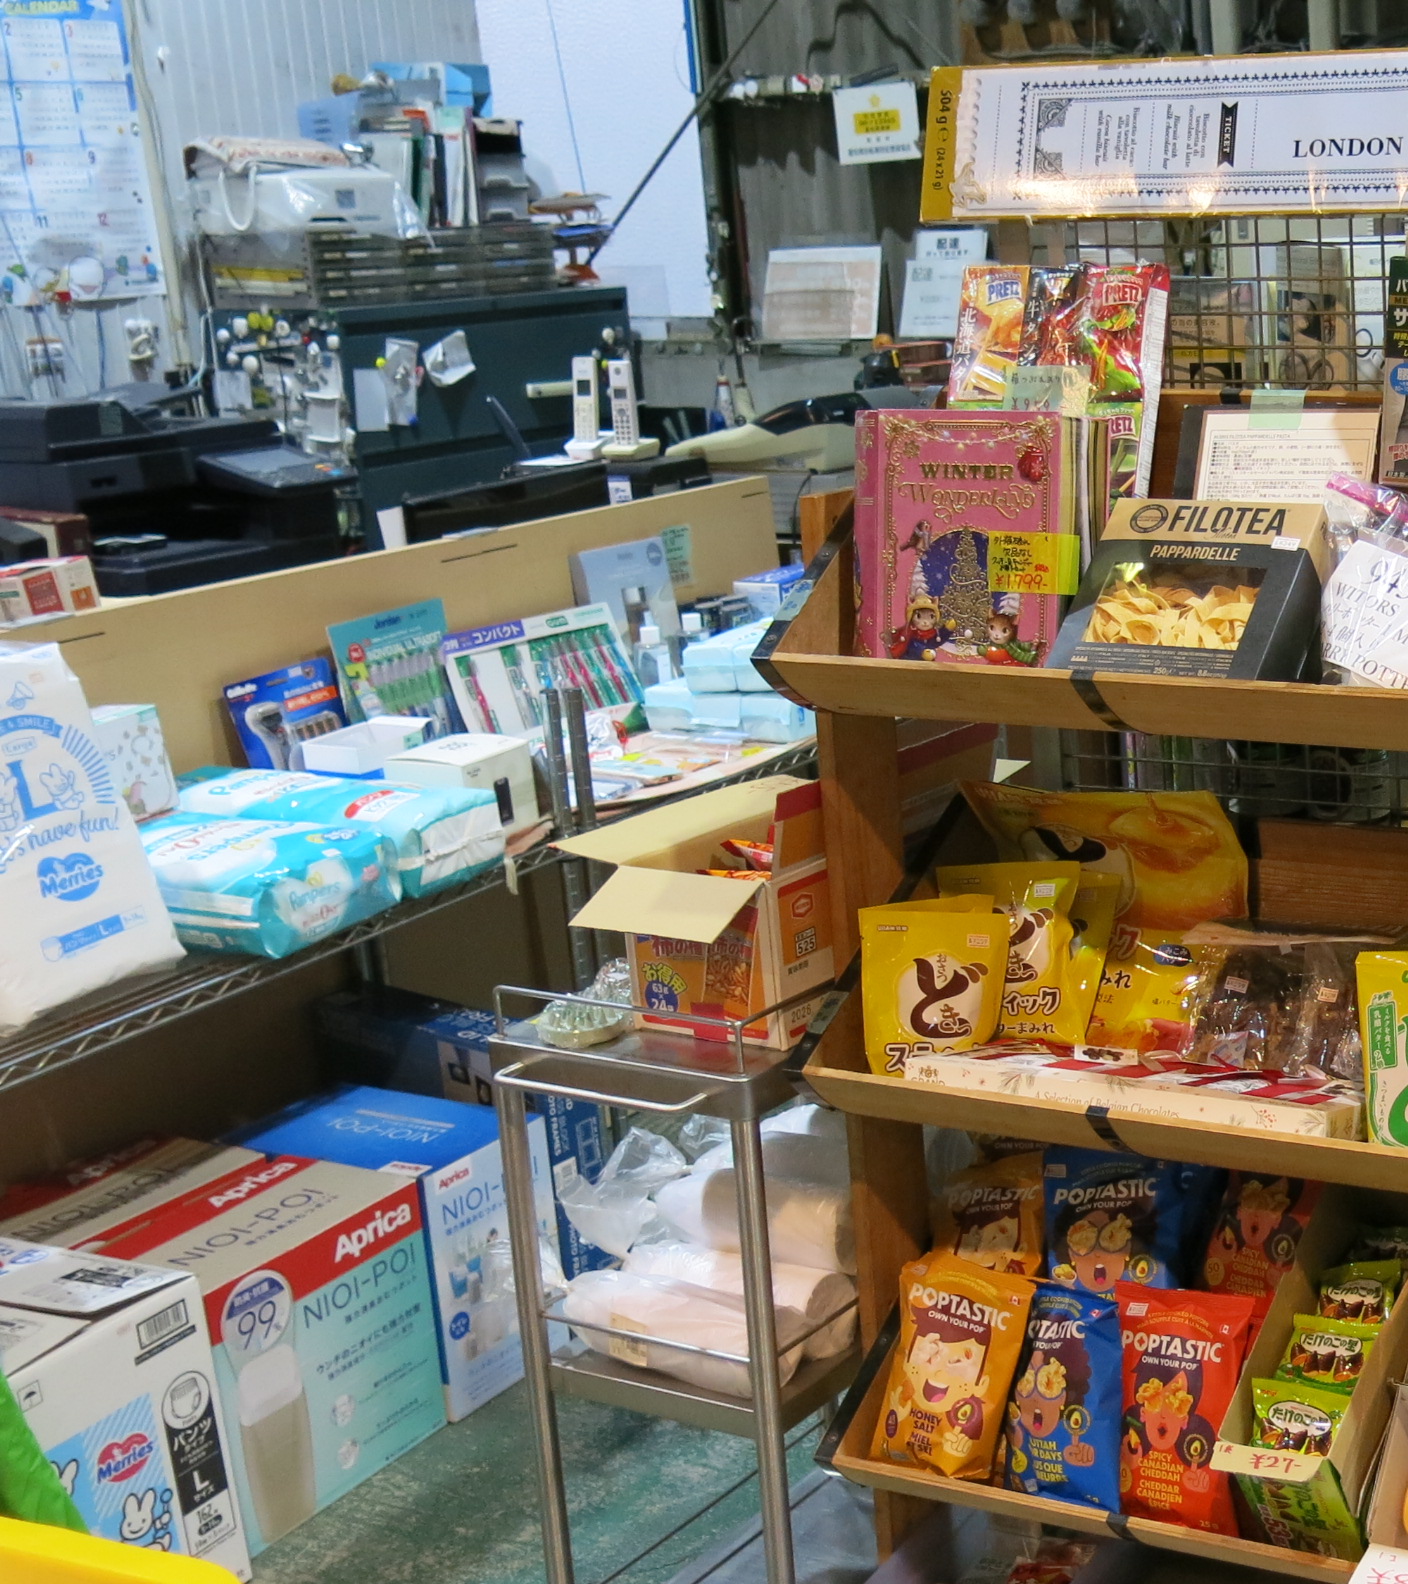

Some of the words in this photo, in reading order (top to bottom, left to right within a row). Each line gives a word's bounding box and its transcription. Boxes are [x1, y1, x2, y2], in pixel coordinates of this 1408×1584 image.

[940, 89, 951, 114] 504
[1131, 107, 1140, 137] Biscotto
[1172, 114, 1181, 141] Biscuit
[1200, 113, 1210, 143] Biscotto
[1222, 116, 1232, 153] TICKET
[1292, 136, 1404, 159] LONDON
[986, 279, 1023, 305] PRETZ
[952, 307, 977, 394] 北海道バター
[920, 461, 1015, 481] WINTER
[1167, 505, 1287, 536] FILOTEA
[1150, 544, 1241, 562] PAPPARDELLE
[1334, 582, 1401, 618] WITORS
[472, 624, 522, 651] コンパクト
[6, 759, 61, 822] L
[79, 806, 120, 843] fun!
[40, 863, 105, 899] Merries
[289, 881, 342, 912] Pampers
[796, 936, 817, 956] 525
[641, 962, 688, 995] お得用
[790, 1004, 813, 1023] 2026
[1044, 1092, 1082, 1106] Selection
[1095, 1098, 1128, 1113] Belgian
[1130, 1103, 1180, 1119] Chocolates
[326, 1116, 440, 1145] NIOI-POI
[208, 1161, 298, 1209] Aprica
[438, 1166, 470, 1190] Aprica
[1053, 1177, 1159, 1206] POPTASTIC
[11, 1167, 171, 1241] NIOI-POI
[1093, 1201, 1115, 1210] YOUR
[1115, 1200, 1132, 1208] POP
[166, 1187, 324, 1267] NIOI-POI
[333, 1202, 413, 1264] Aprica
[302, 1242, 417, 1329] NIOI-POI
[908, 1283, 1010, 1331] POPTASTIC
[928, 1310, 949, 1323] OWN
[949, 1316, 970, 1329] YOUR
[969, 1321, 986, 1334] POP
[1122, 1330, 1223, 1364] POPTASTIC
[1301, 1331, 1361, 1351] たけのこの里
[1141, 1355, 1160, 1366] OWN
[1160, 1357, 1180, 1368] YOUR
[1180, 1361, 1199, 1371] POP
[910, 1408, 942, 1425] HONEY
[913, 1420, 936, 1434] SALT
[1271, 1405, 1332, 1432] たけのこの里
[173, 1415, 213, 1453] パンツ
[910, 1432, 932, 1446] MIEL
[97, 1439, 156, 1483] Merries
[1137, 1457, 1184, 1474] CANADIAN
[1149, 1451, 1173, 1462] SPICY
[193, 1471, 212, 1493] L
[1139, 1467, 1181, 1482] CHEDDAH
[1139, 1479, 1181, 1494] CHEDDAR
[1136, 1487, 1183, 1504] CANADIEN
